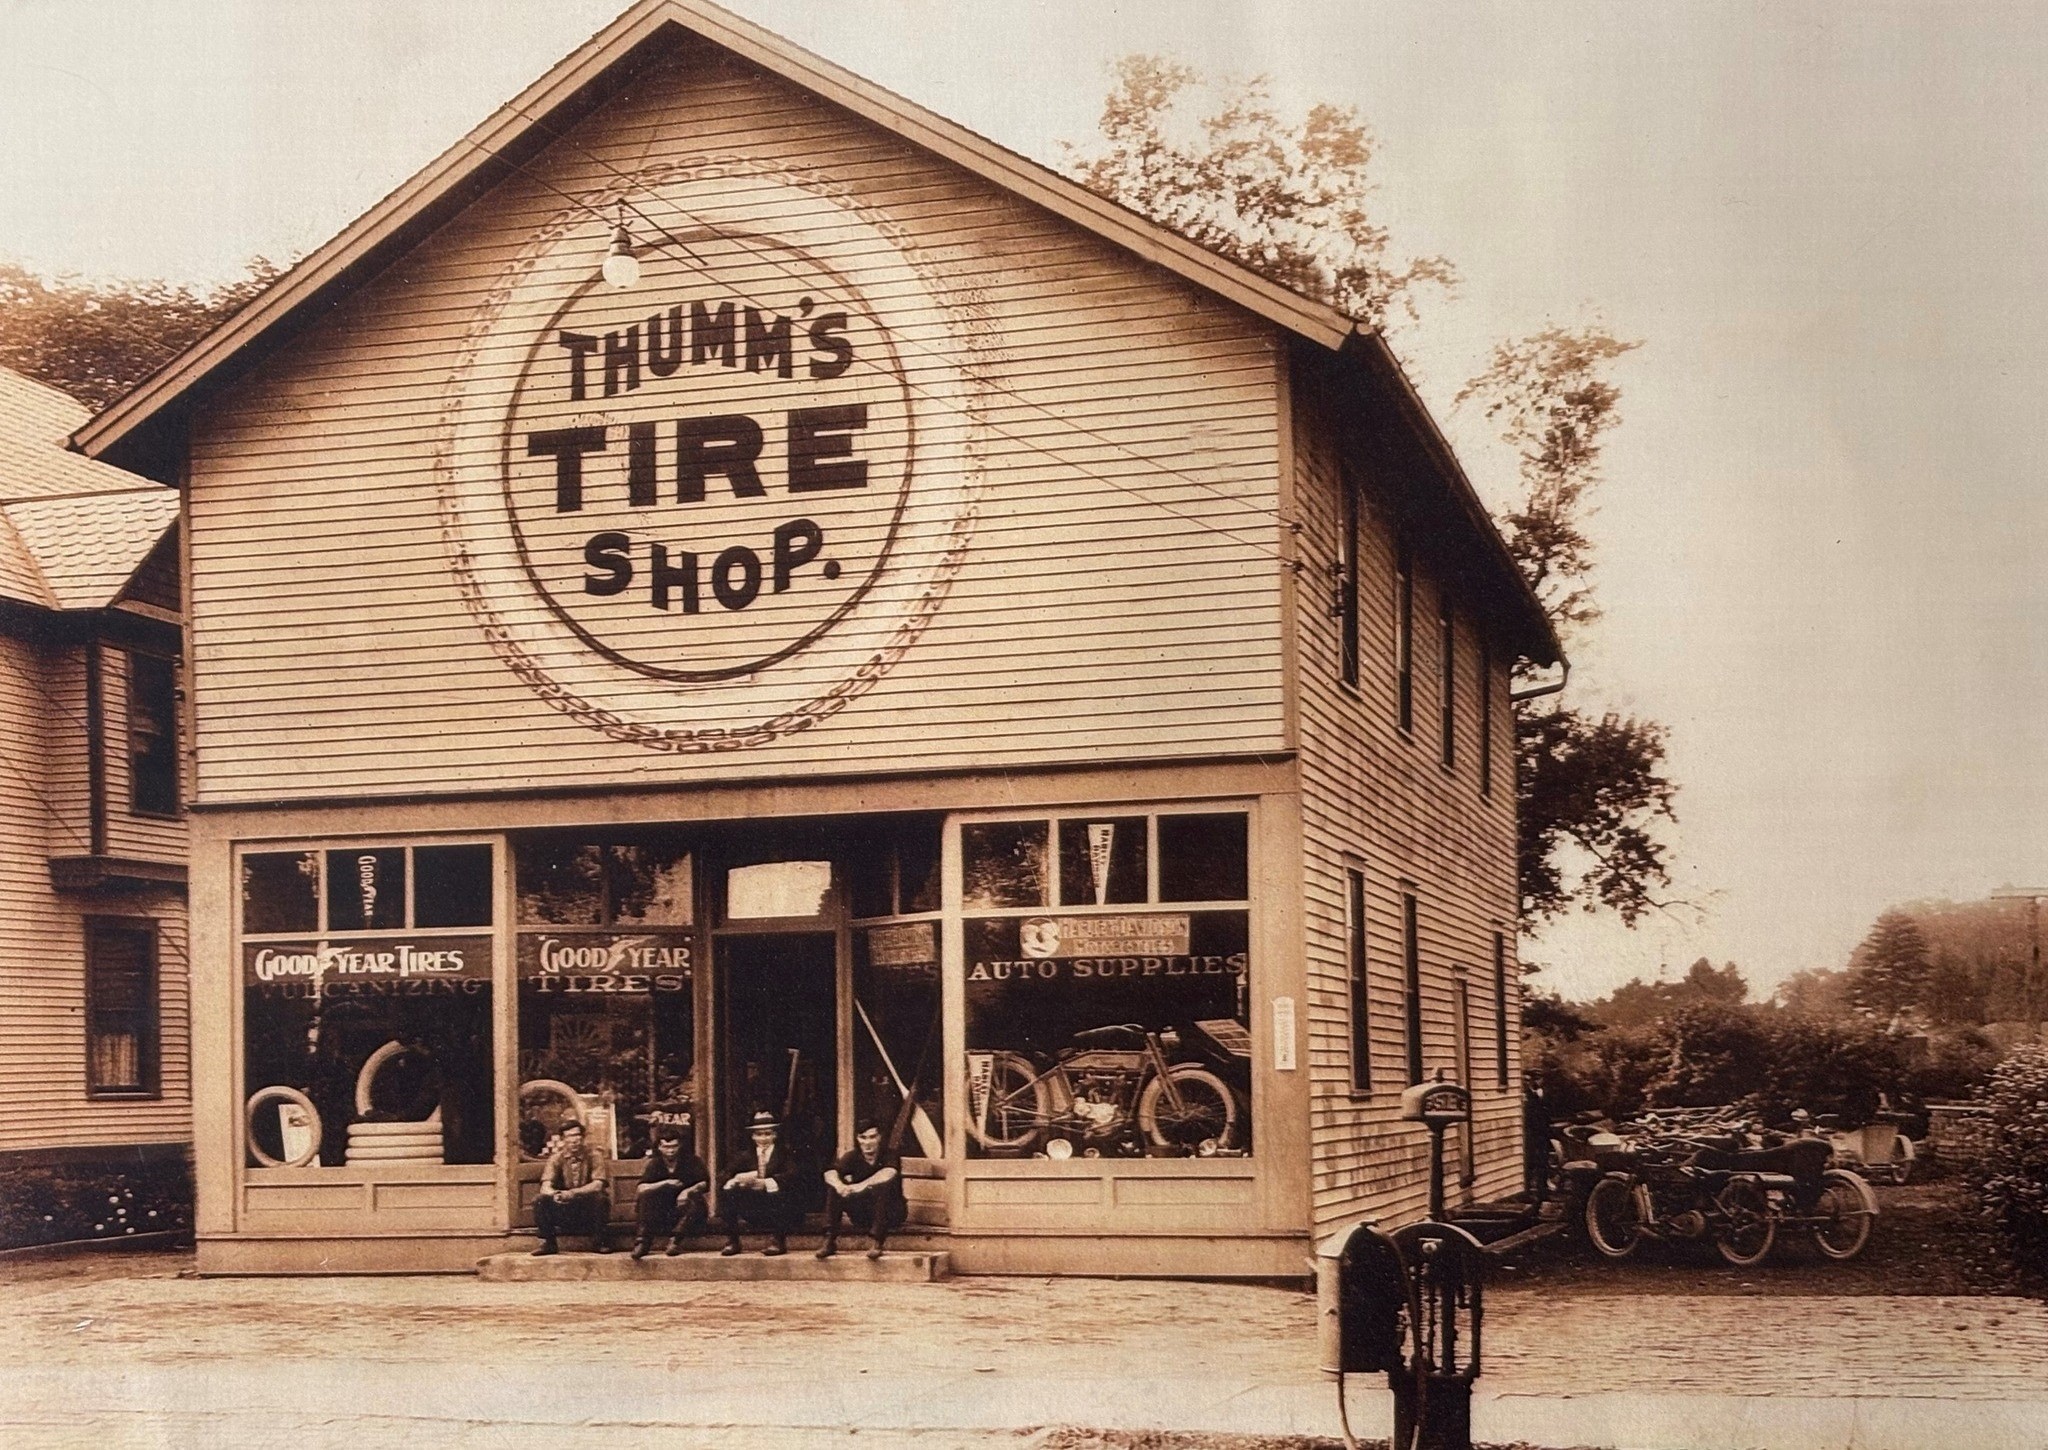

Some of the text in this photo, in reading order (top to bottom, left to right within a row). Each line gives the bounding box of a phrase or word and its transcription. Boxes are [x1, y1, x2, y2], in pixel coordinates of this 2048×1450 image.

[559, 296, 853, 400] THUMM'S
[528, 404, 868, 513] TIRE
[584, 518, 841, 613] SHOP.
[394, 945, 464, 977] TIRES
[967, 960, 1058, 981] AUTO
[1073, 954, 1246, 979] SUPPLIES
[258, 977, 484, 999] VULCANIZING
[528, 974, 684, 992] TIRES
